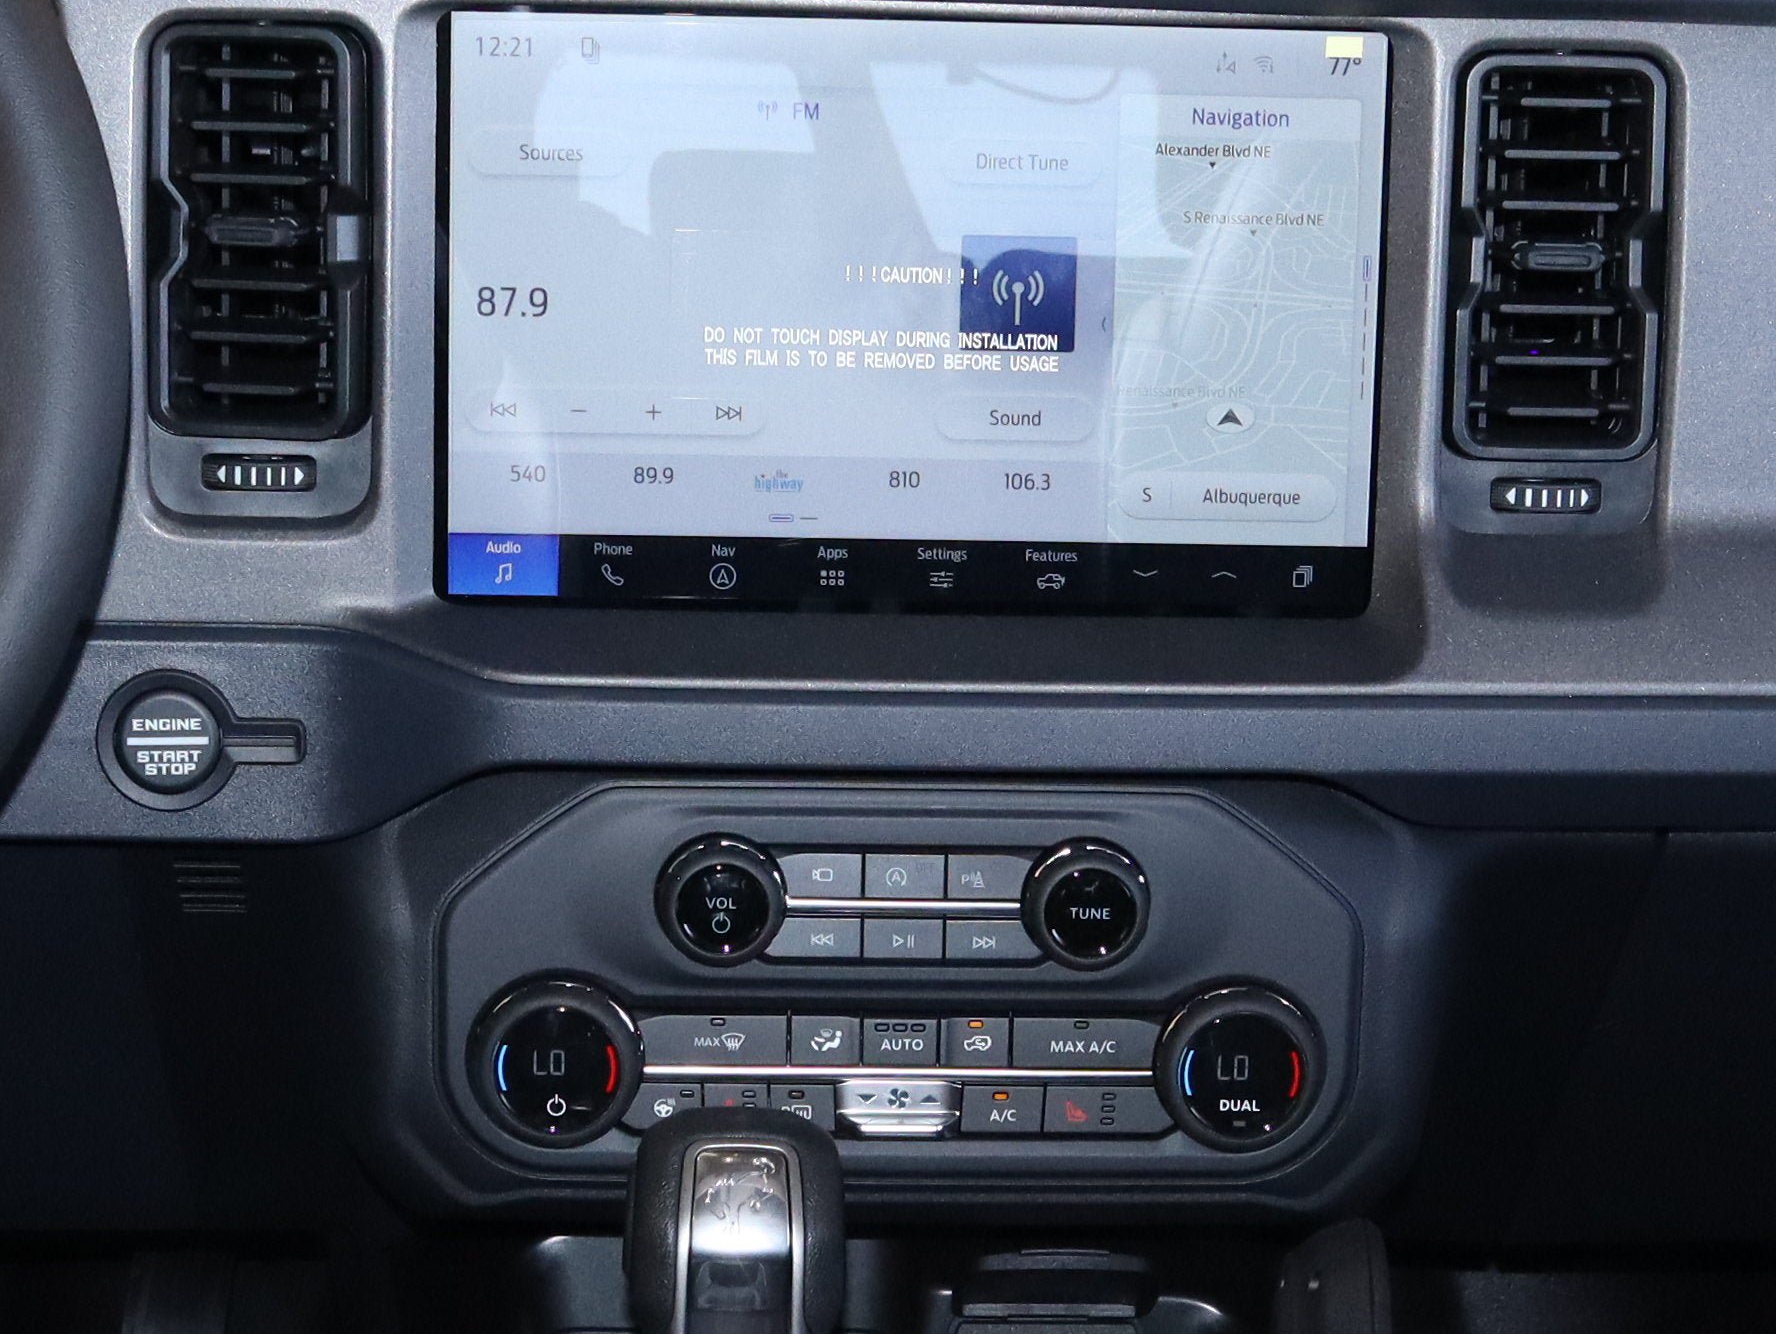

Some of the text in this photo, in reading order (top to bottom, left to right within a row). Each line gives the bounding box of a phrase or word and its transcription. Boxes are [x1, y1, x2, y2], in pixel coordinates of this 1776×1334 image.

[475, 37, 533, 57] 12:21
[793, 102, 819, 120] FM
[1192, 108, 1290, 130] Navigation
[520, 144, 583, 162] Sources
[1155, 144, 1271, 159] Alexander Blvd NE
[976, 153, 1069, 171] Direct Tune
[1183, 212, 1325, 227] S Renaissance Blvd NE
[476, 286, 549, 319] 87.9
[704, 327, 1058, 351] DO NOT TOUCH DISPLAY DURING INSTALLATION
[705, 349, 1059, 372] THIS FILM IS TO BE REMOVED BEFORE USAGE
[990, 409, 1042, 427] Sound
[510, 465, 546, 483] 540
[633, 467, 674, 484] 89.9
[889, 471, 920, 489] 810
[754, 474, 804, 492] highway
[1004, 473, 1051, 491] 106.3
[1142, 488, 1152, 503] S
[1202, 487, 1301, 508] Albuquerque
[486, 540, 521, 554] Audio
[593, 542, 633, 556] Phone
[711, 544, 736, 557] Nav
[817, 546, 848, 561] Apps
[917, 547, 968, 563] Settings
[1025, 548, 1078, 563] Features
[131, 718, 202, 731] ENGINE
[137, 751, 202, 763] START
[144, 763, 197, 775] STOP
[705, 897, 737, 910] VOL
[1070, 908, 1111, 920] TUNE
[694, 1036, 720, 1047] MAX
[880, 1038, 924, 1051] AUTO
[1050, 1040, 1116, 1054] MAX A/C
[1219, 1099, 1260, 1112] DUAL
[990, 1109, 1016, 1122] A/C
